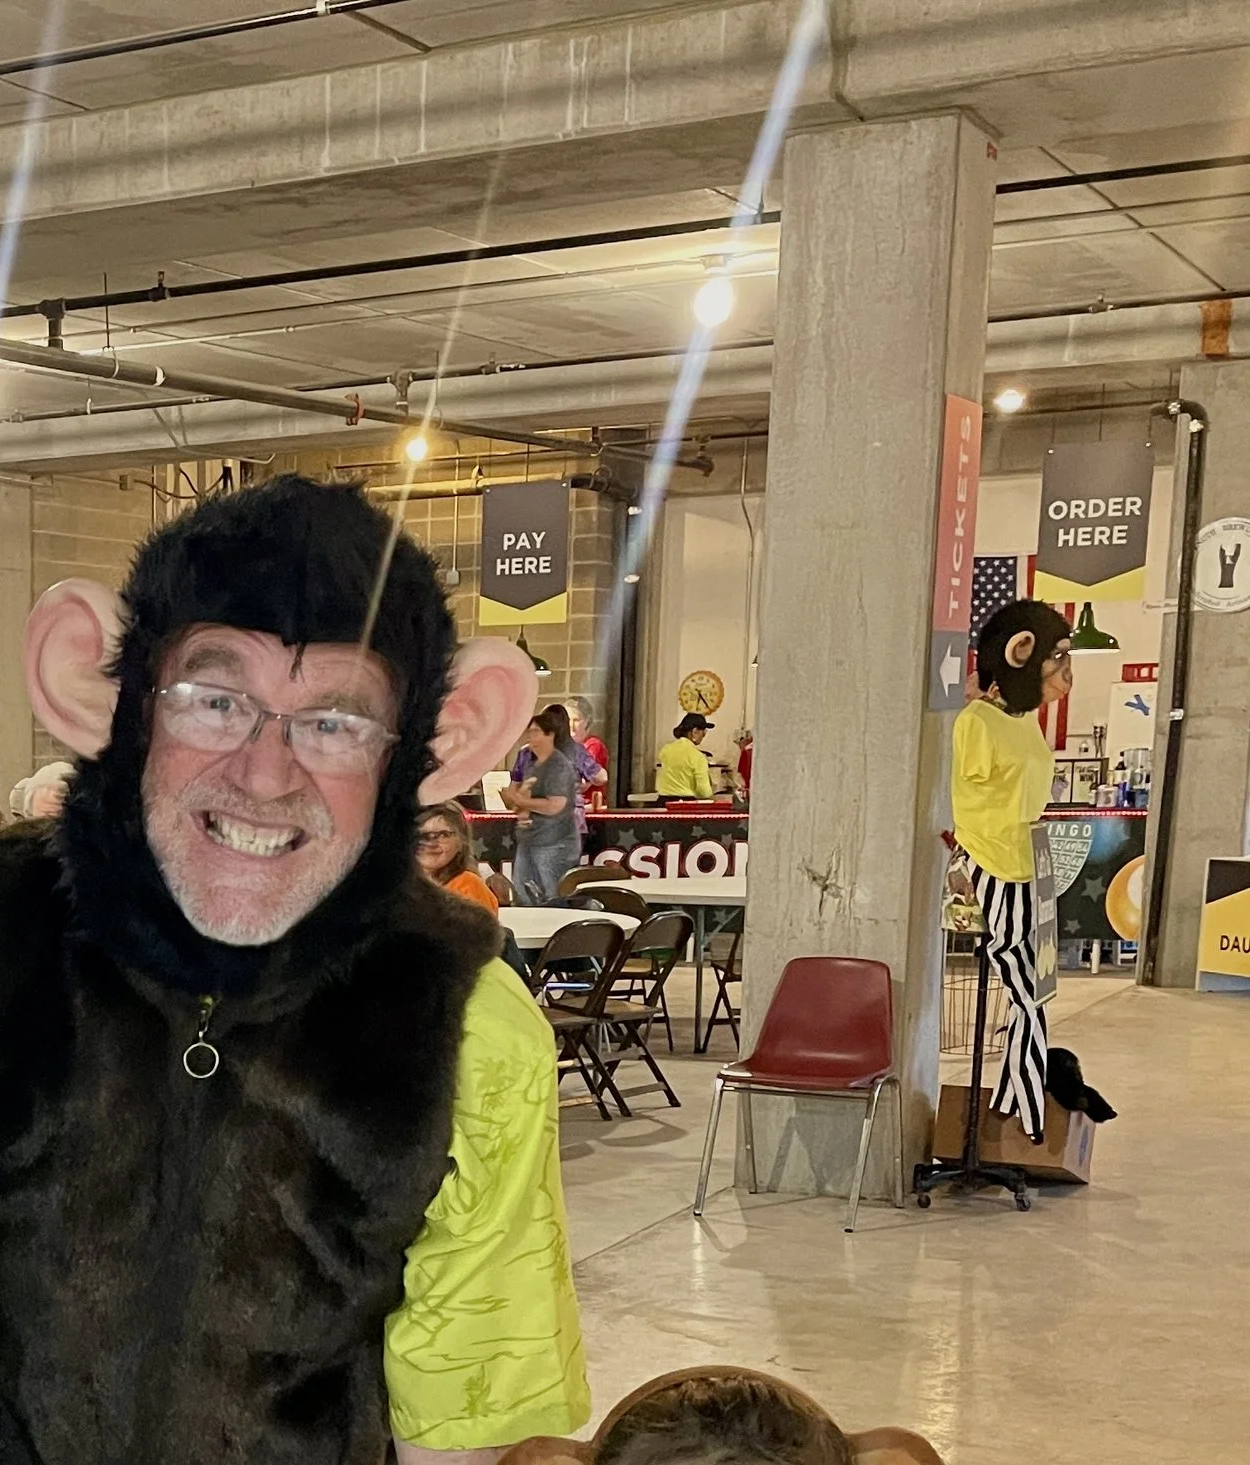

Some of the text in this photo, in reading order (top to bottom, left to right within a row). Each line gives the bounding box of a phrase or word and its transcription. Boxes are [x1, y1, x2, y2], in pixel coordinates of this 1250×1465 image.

[949, 414, 972, 619] TICKETS
[1048, 496, 1142, 520] ORDER
[503, 531, 546, 550] PAY
[1057, 524, 1128, 547] HERE
[496, 556, 552, 575] HERE
[1047, 823, 1092, 837] INGO
